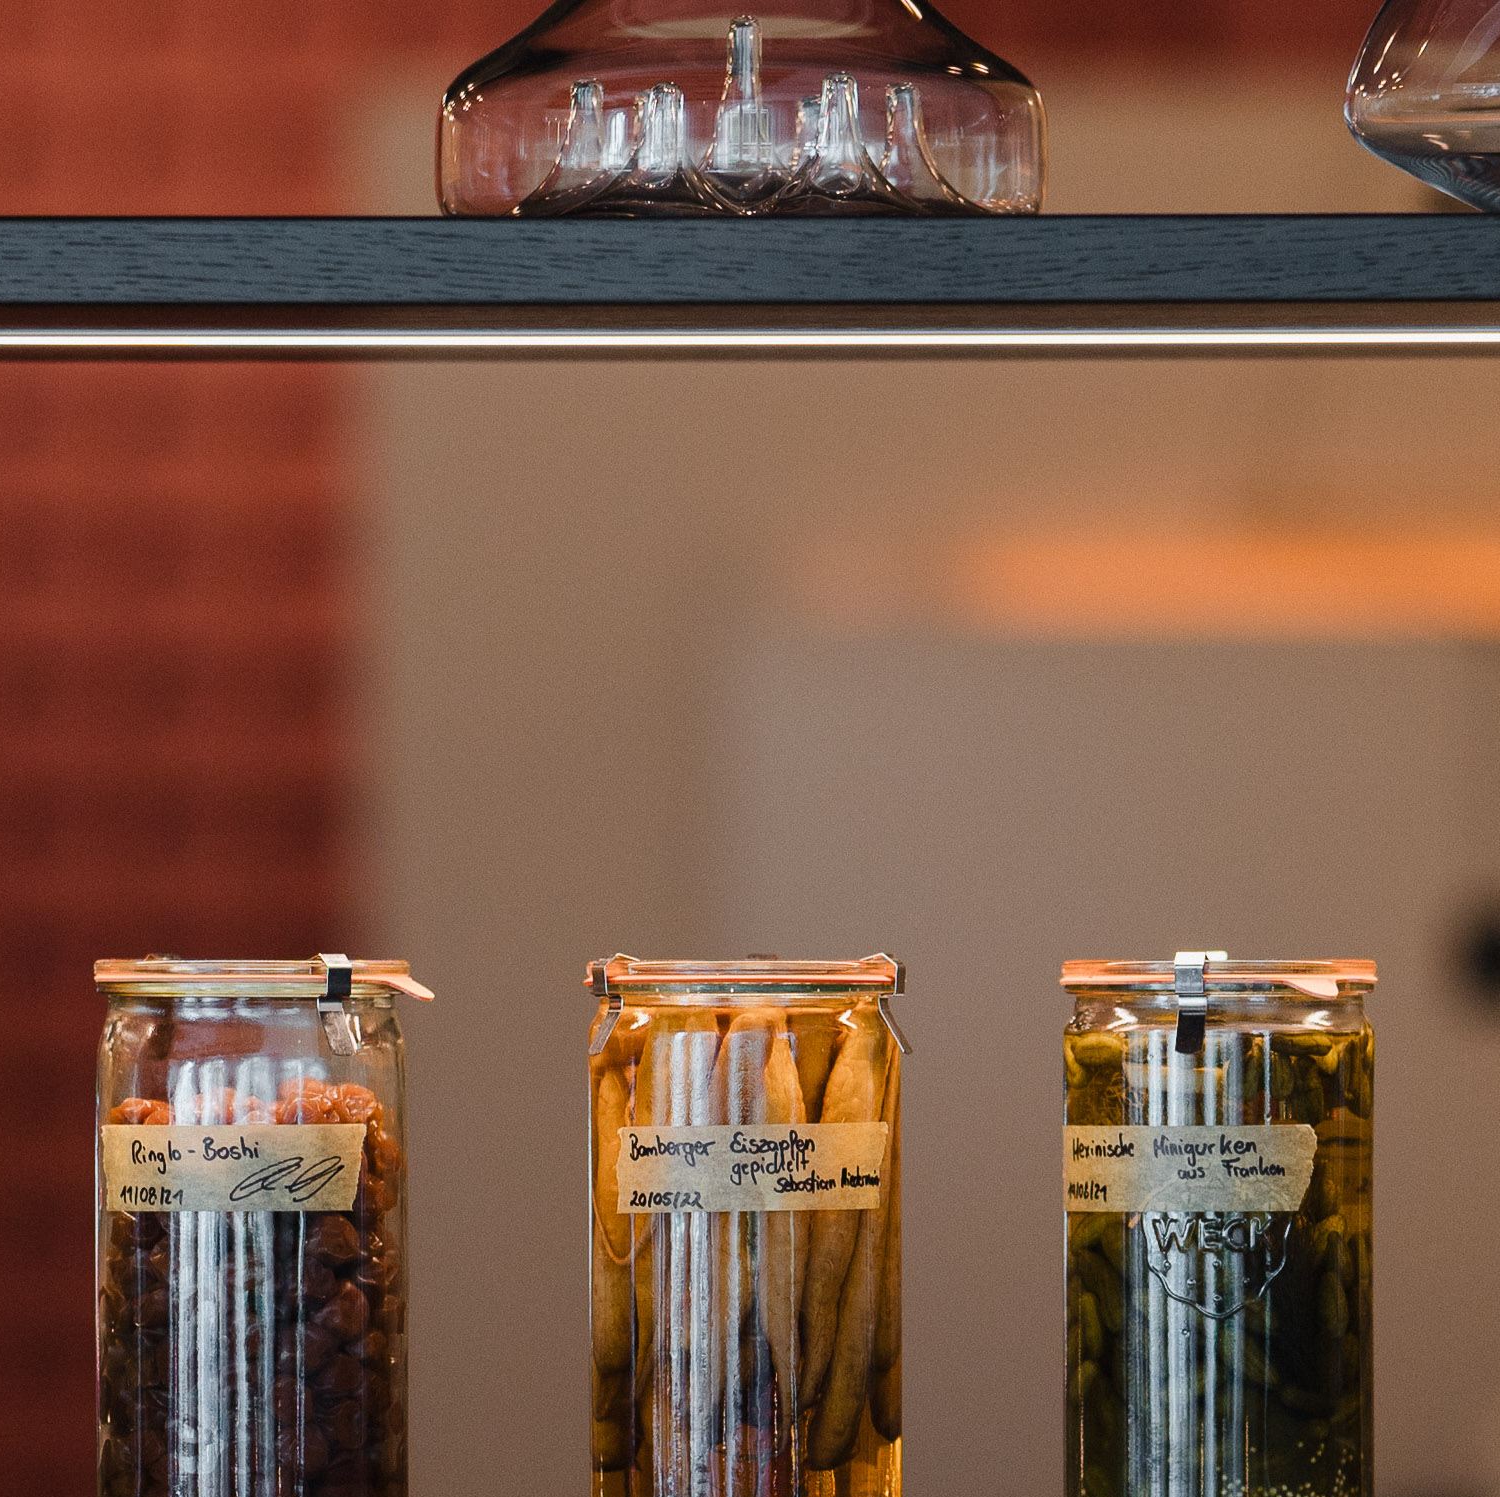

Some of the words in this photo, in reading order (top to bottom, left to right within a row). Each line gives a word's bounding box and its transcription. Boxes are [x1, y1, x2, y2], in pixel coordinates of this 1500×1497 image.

[629, 1133, 716, 1167] Bamberger
[729, 1130, 816, 1160] Eiszapfen
[1153, 1134, 1258, 1167] Minigurken
[729, 1150, 810, 1186] gepickelt
[773, 1169, 837, 1195] Sebastian
[1177, 1168, 1206, 1181] aus
[1222, 1156, 1286, 1178] Franken
[120, 1185, 184, 1206] 11/08/21
[629, 1190, 704, 1209] 20/05/22
[1152, 1217, 1273, 1254] WECK
